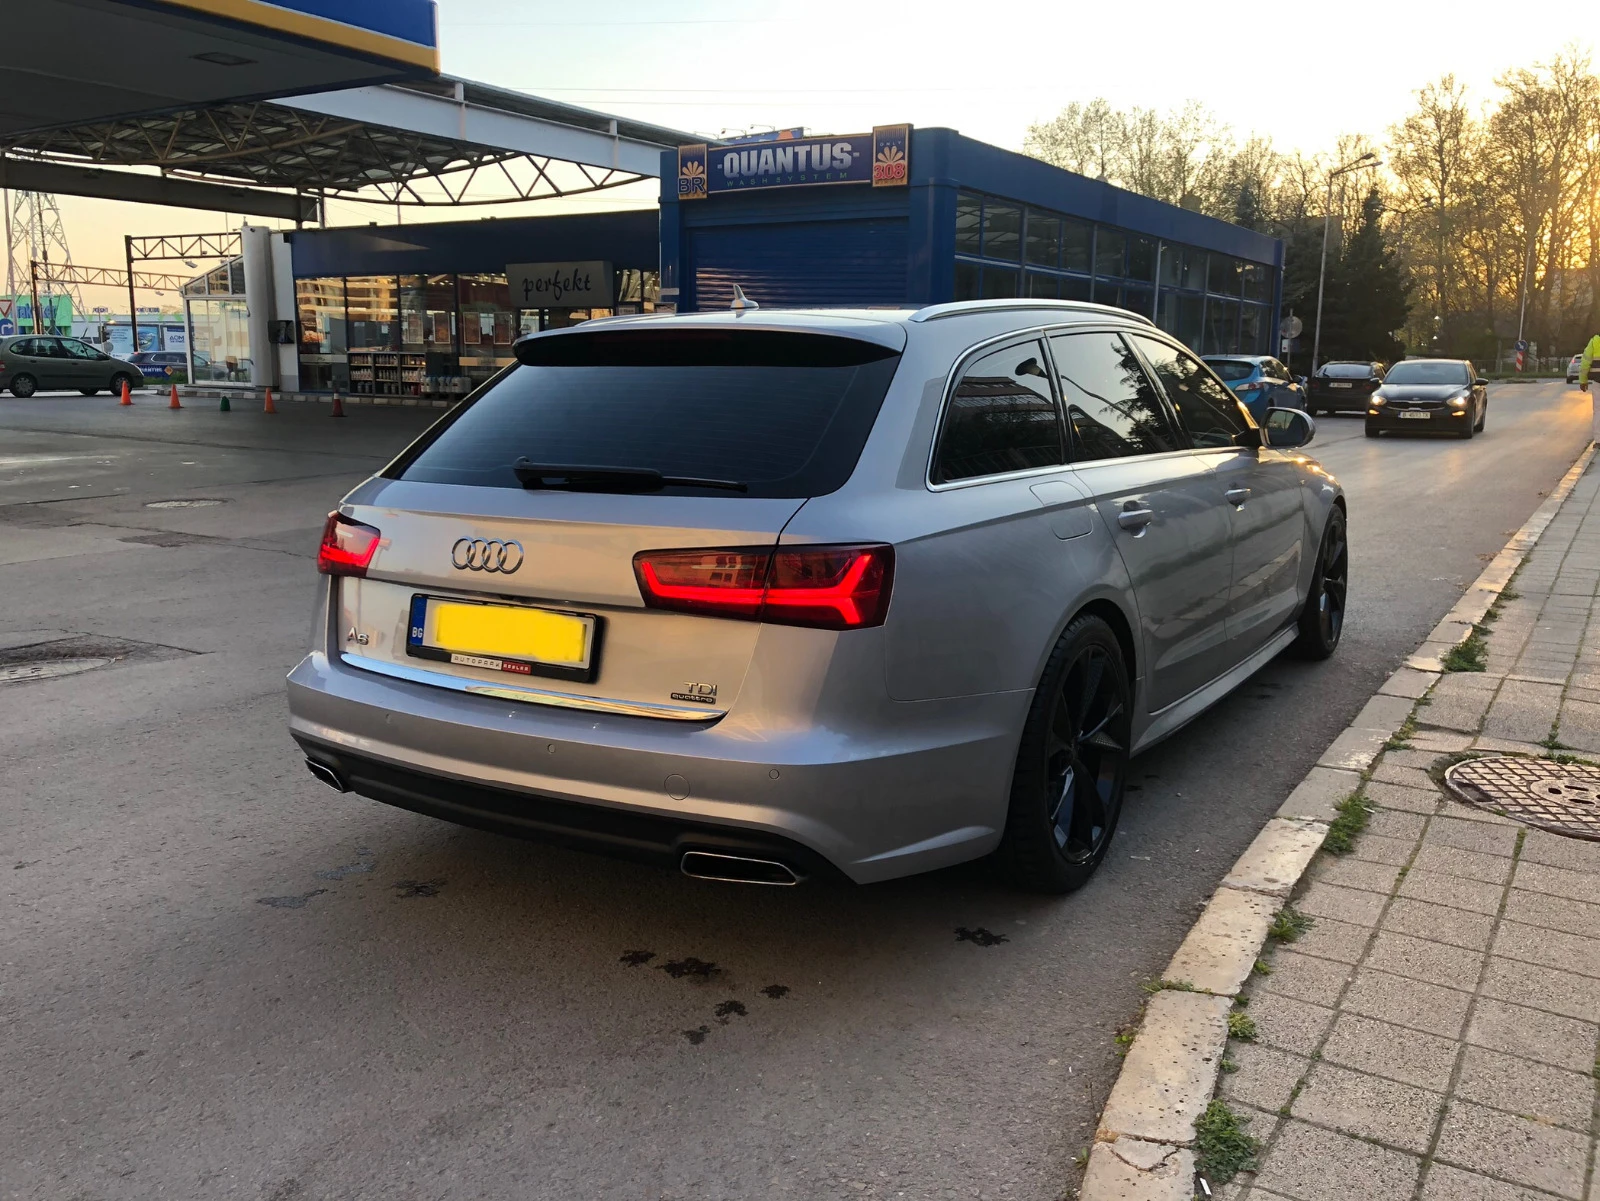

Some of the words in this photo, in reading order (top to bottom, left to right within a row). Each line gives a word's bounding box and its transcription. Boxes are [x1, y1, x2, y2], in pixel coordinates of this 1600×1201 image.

[723, 142, 852, 178] QUANTUS
[873, 162, 906, 180] 3.08
[522, 268, 592, 301] perfekt
[347, 626, 369, 645] A6
[411, 626, 424, 638] BG
[454, 656, 501, 668] AUTOPARK
[683, 681, 718, 696] TDI
[671, 692, 713, 703] quattro
